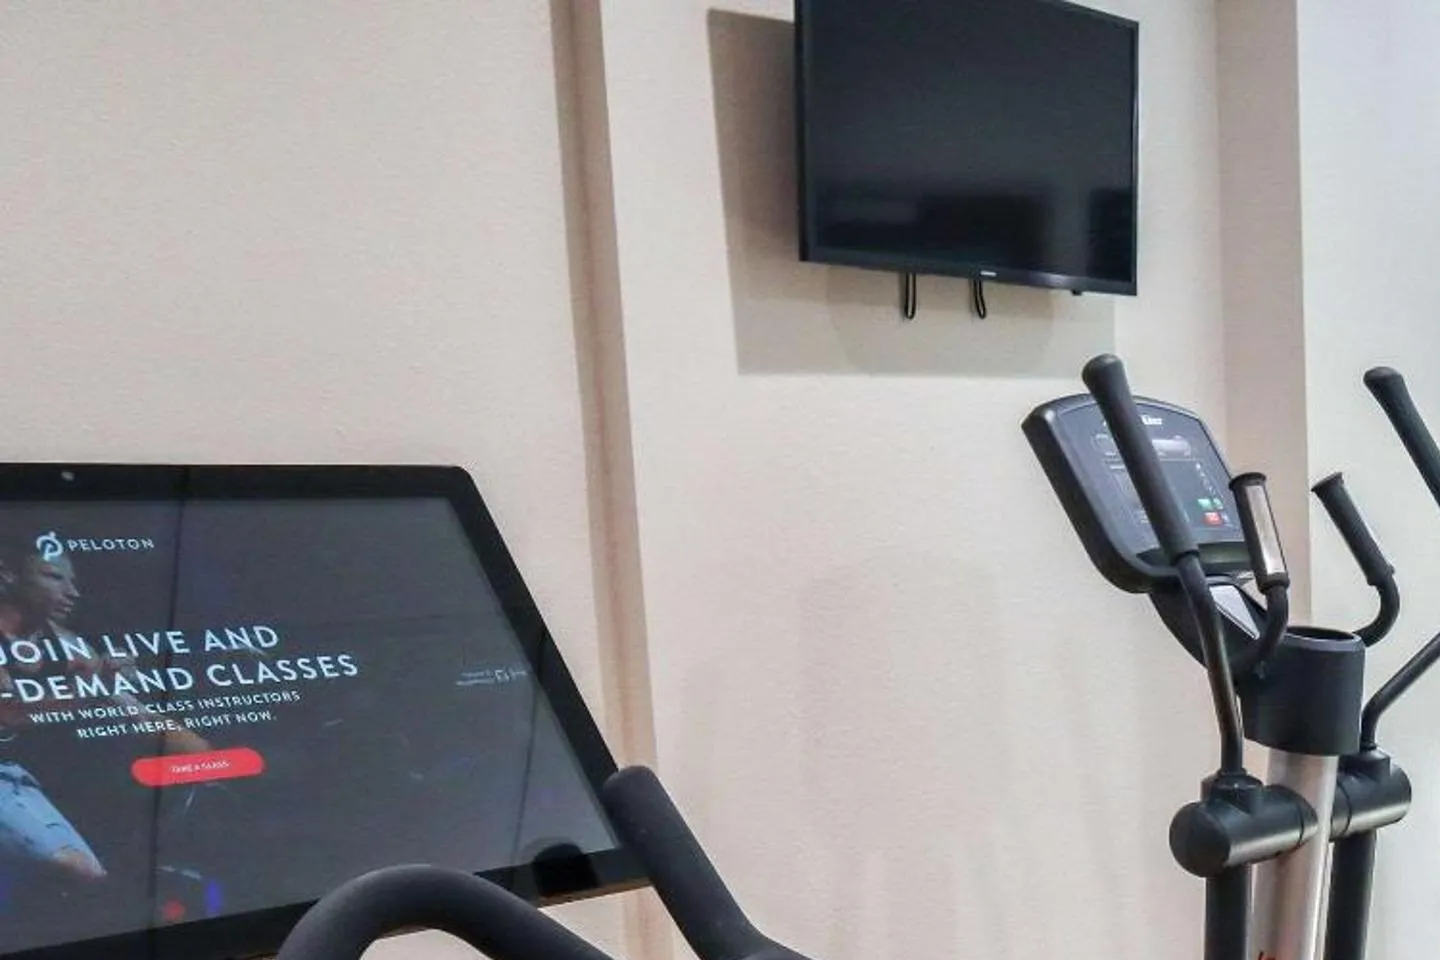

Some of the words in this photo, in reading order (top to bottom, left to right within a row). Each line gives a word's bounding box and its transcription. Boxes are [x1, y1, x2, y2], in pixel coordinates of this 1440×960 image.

[67, 538, 155, 551] PELOTON
[102, 630, 192, 660] LIVE
[203, 624, 281, 654] AND
[205, 653, 359, 690] CLASSES
[30, 711, 76, 723] WITH
[145, 700, 195, 714] CLASS
[198, 690, 301, 710] INSTRUCTORS
[76, 723, 128, 738] RIGHT
[131, 719, 182, 733] HERE,
[184, 714, 231, 729] RIGHT
